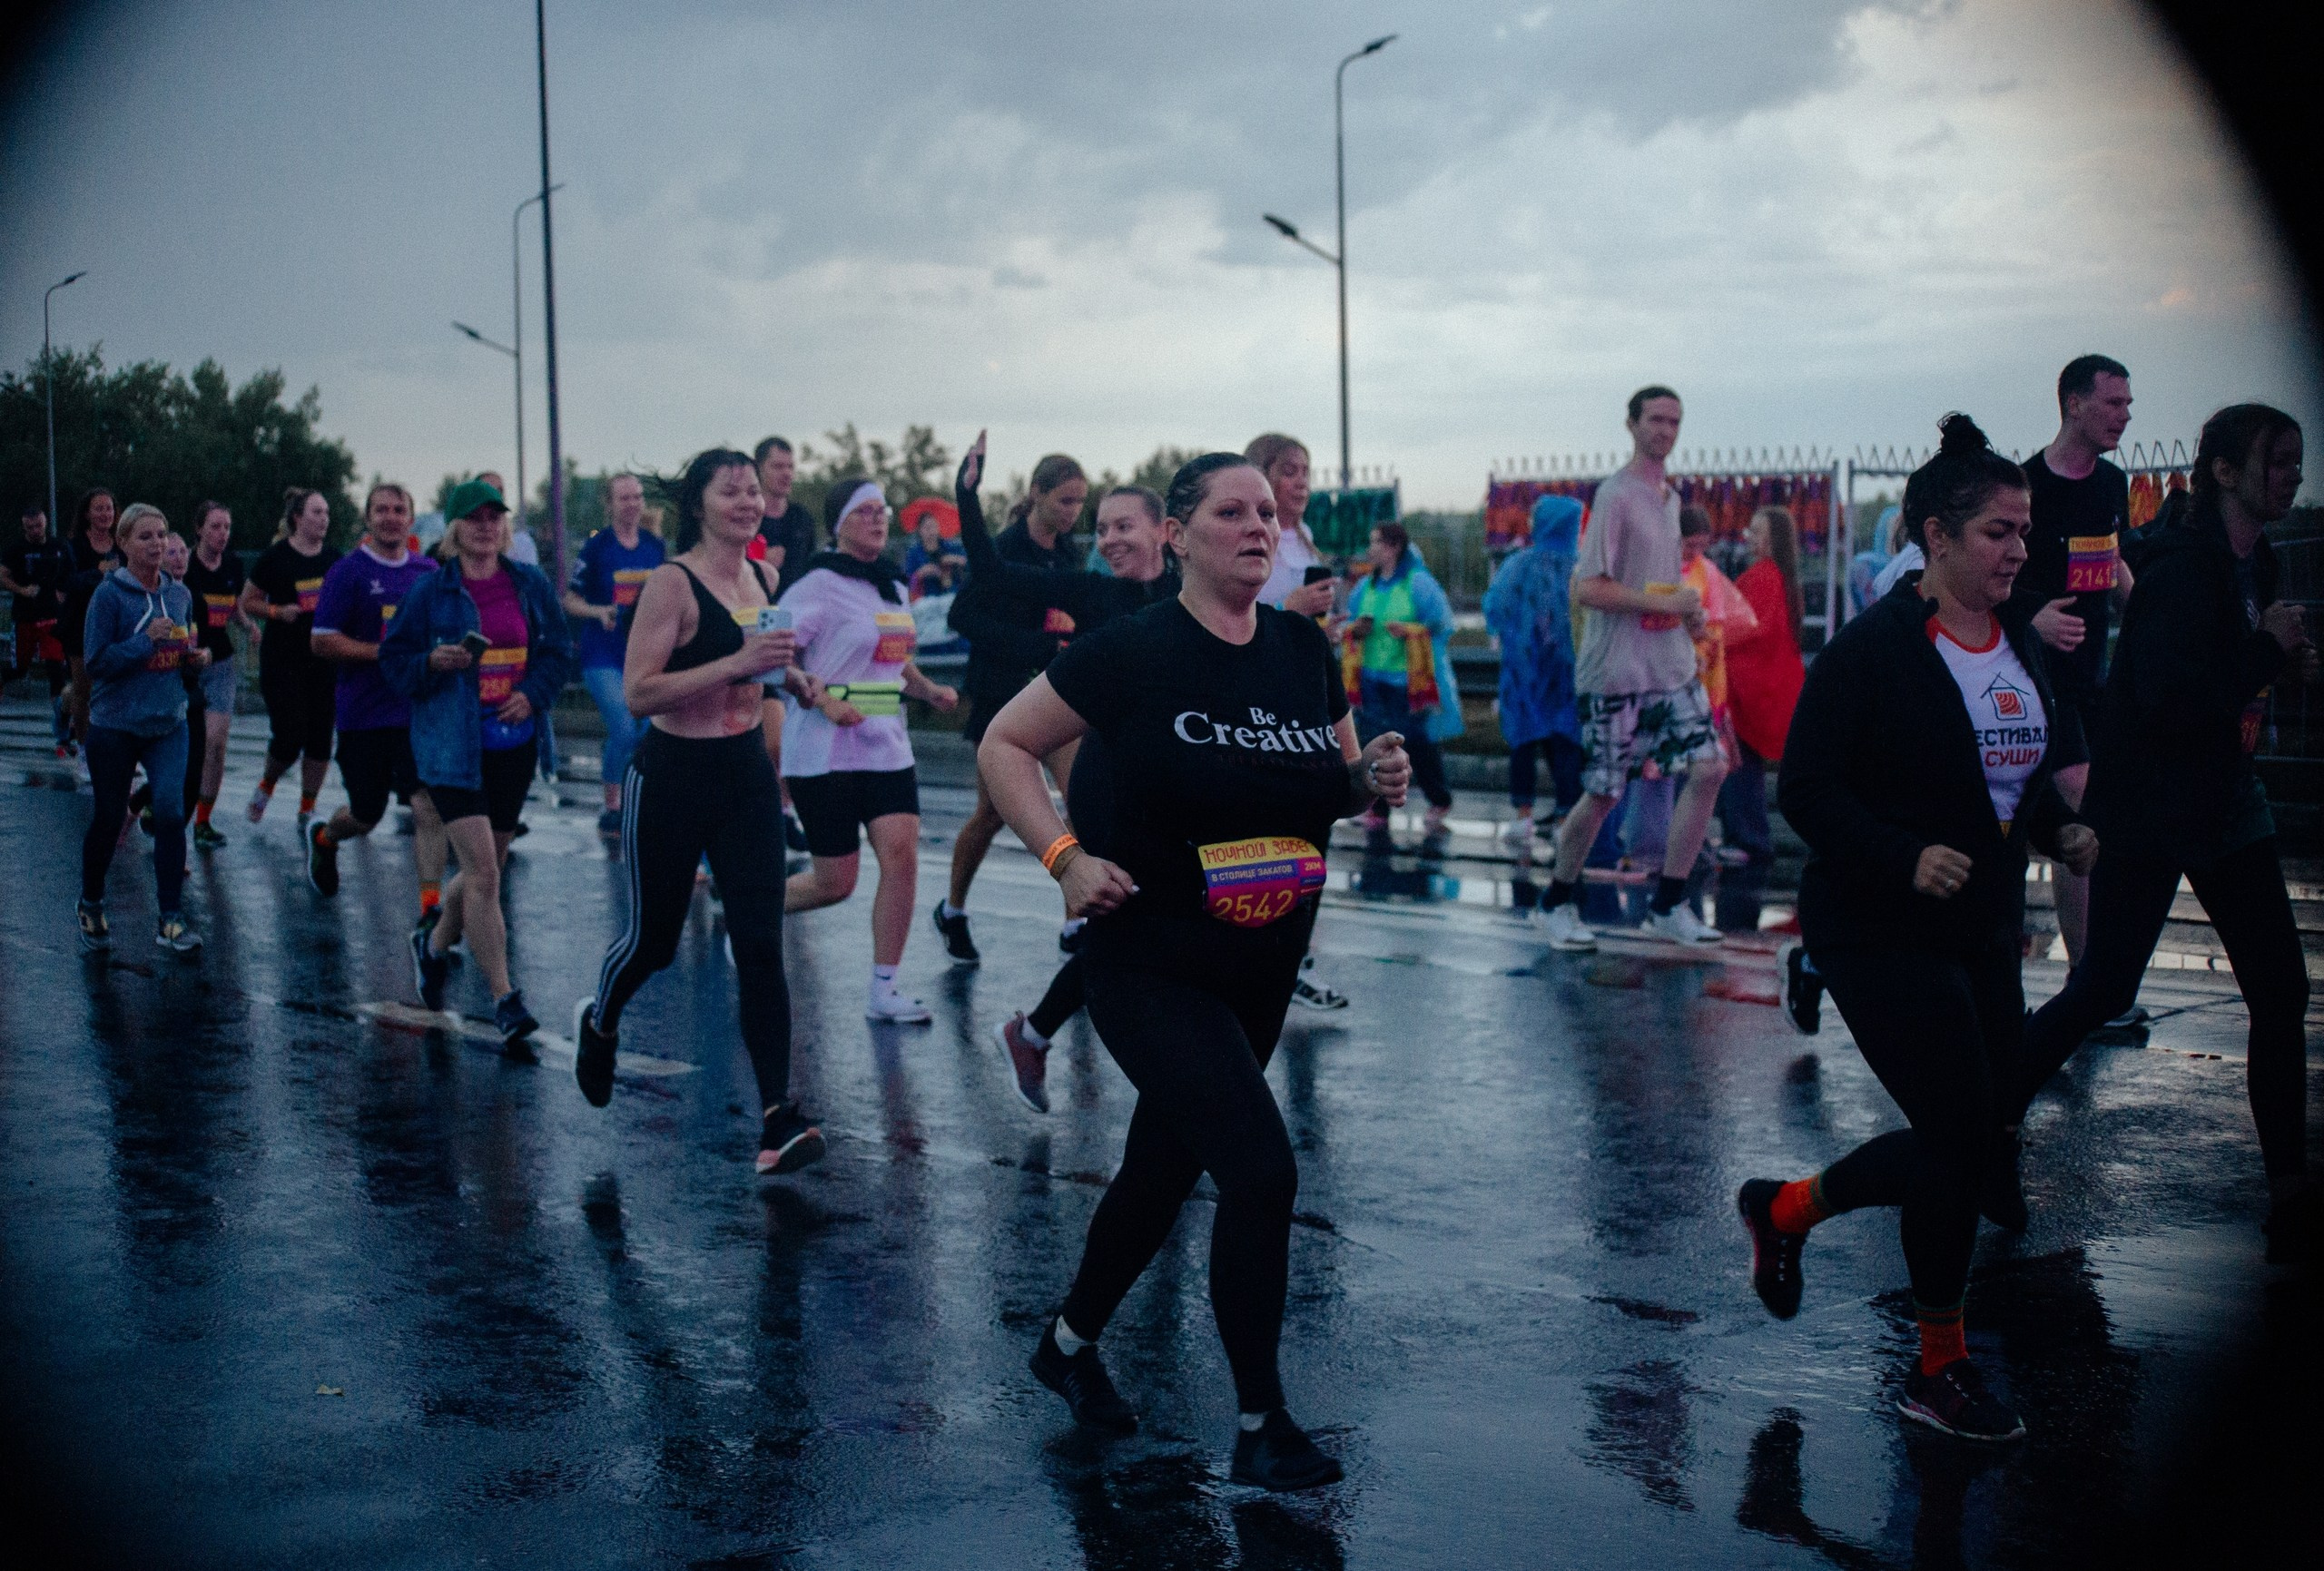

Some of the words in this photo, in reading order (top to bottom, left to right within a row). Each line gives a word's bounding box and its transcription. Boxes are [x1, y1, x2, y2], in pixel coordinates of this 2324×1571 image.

[2070, 565, 2112, 589] 2141
[1249, 707, 1277, 725] Be
[1174, 711, 1341, 752] Creative
[1976, 727, 2048, 747] ЕСТИВА
[1985, 749, 2040, 767] СУШИ
[1204, 841, 1267, 864] НОЧНОЙ
[1272, 840, 1310, 856] ЗАБЕ
[1219, 868, 1256, 881] СТОЛИЦЕ
[1257, 864, 1293, 877] ЗАКАТОВ
[1213, 889, 1294, 923] 2542
